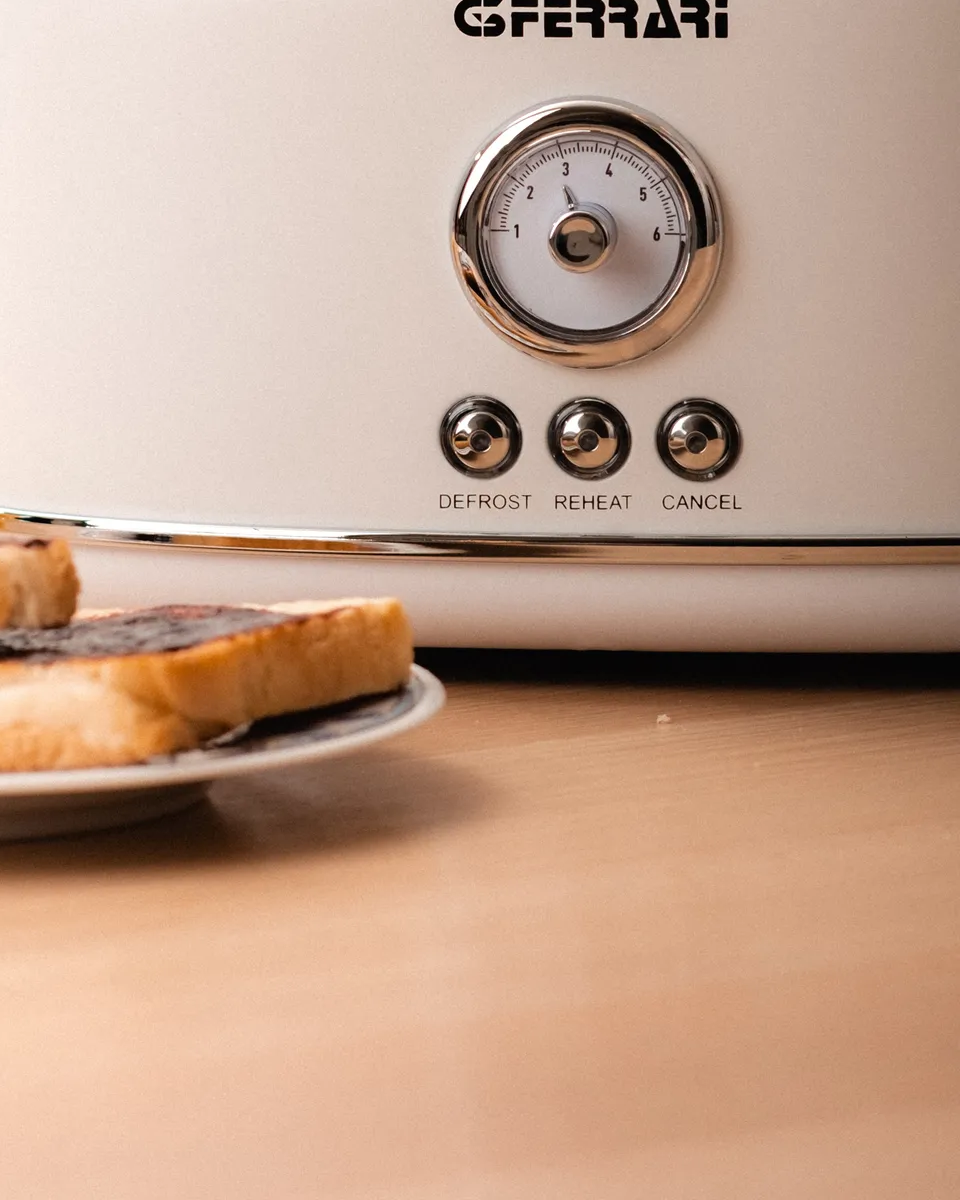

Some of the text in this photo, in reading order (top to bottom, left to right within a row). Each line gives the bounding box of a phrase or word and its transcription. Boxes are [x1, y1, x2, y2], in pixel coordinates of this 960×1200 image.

[562, 161, 570, 177] 3
[605, 162, 614, 178] 4
[526, 185, 534, 200] 2
[639, 186, 647, 202] 5
[513, 223, 520, 239] 1
[652, 226, 661, 242] 6
[439, 494, 532, 510] DEFROST
[554, 494, 632, 511] REHEAT
[662, 494, 743, 511] CANCEL
